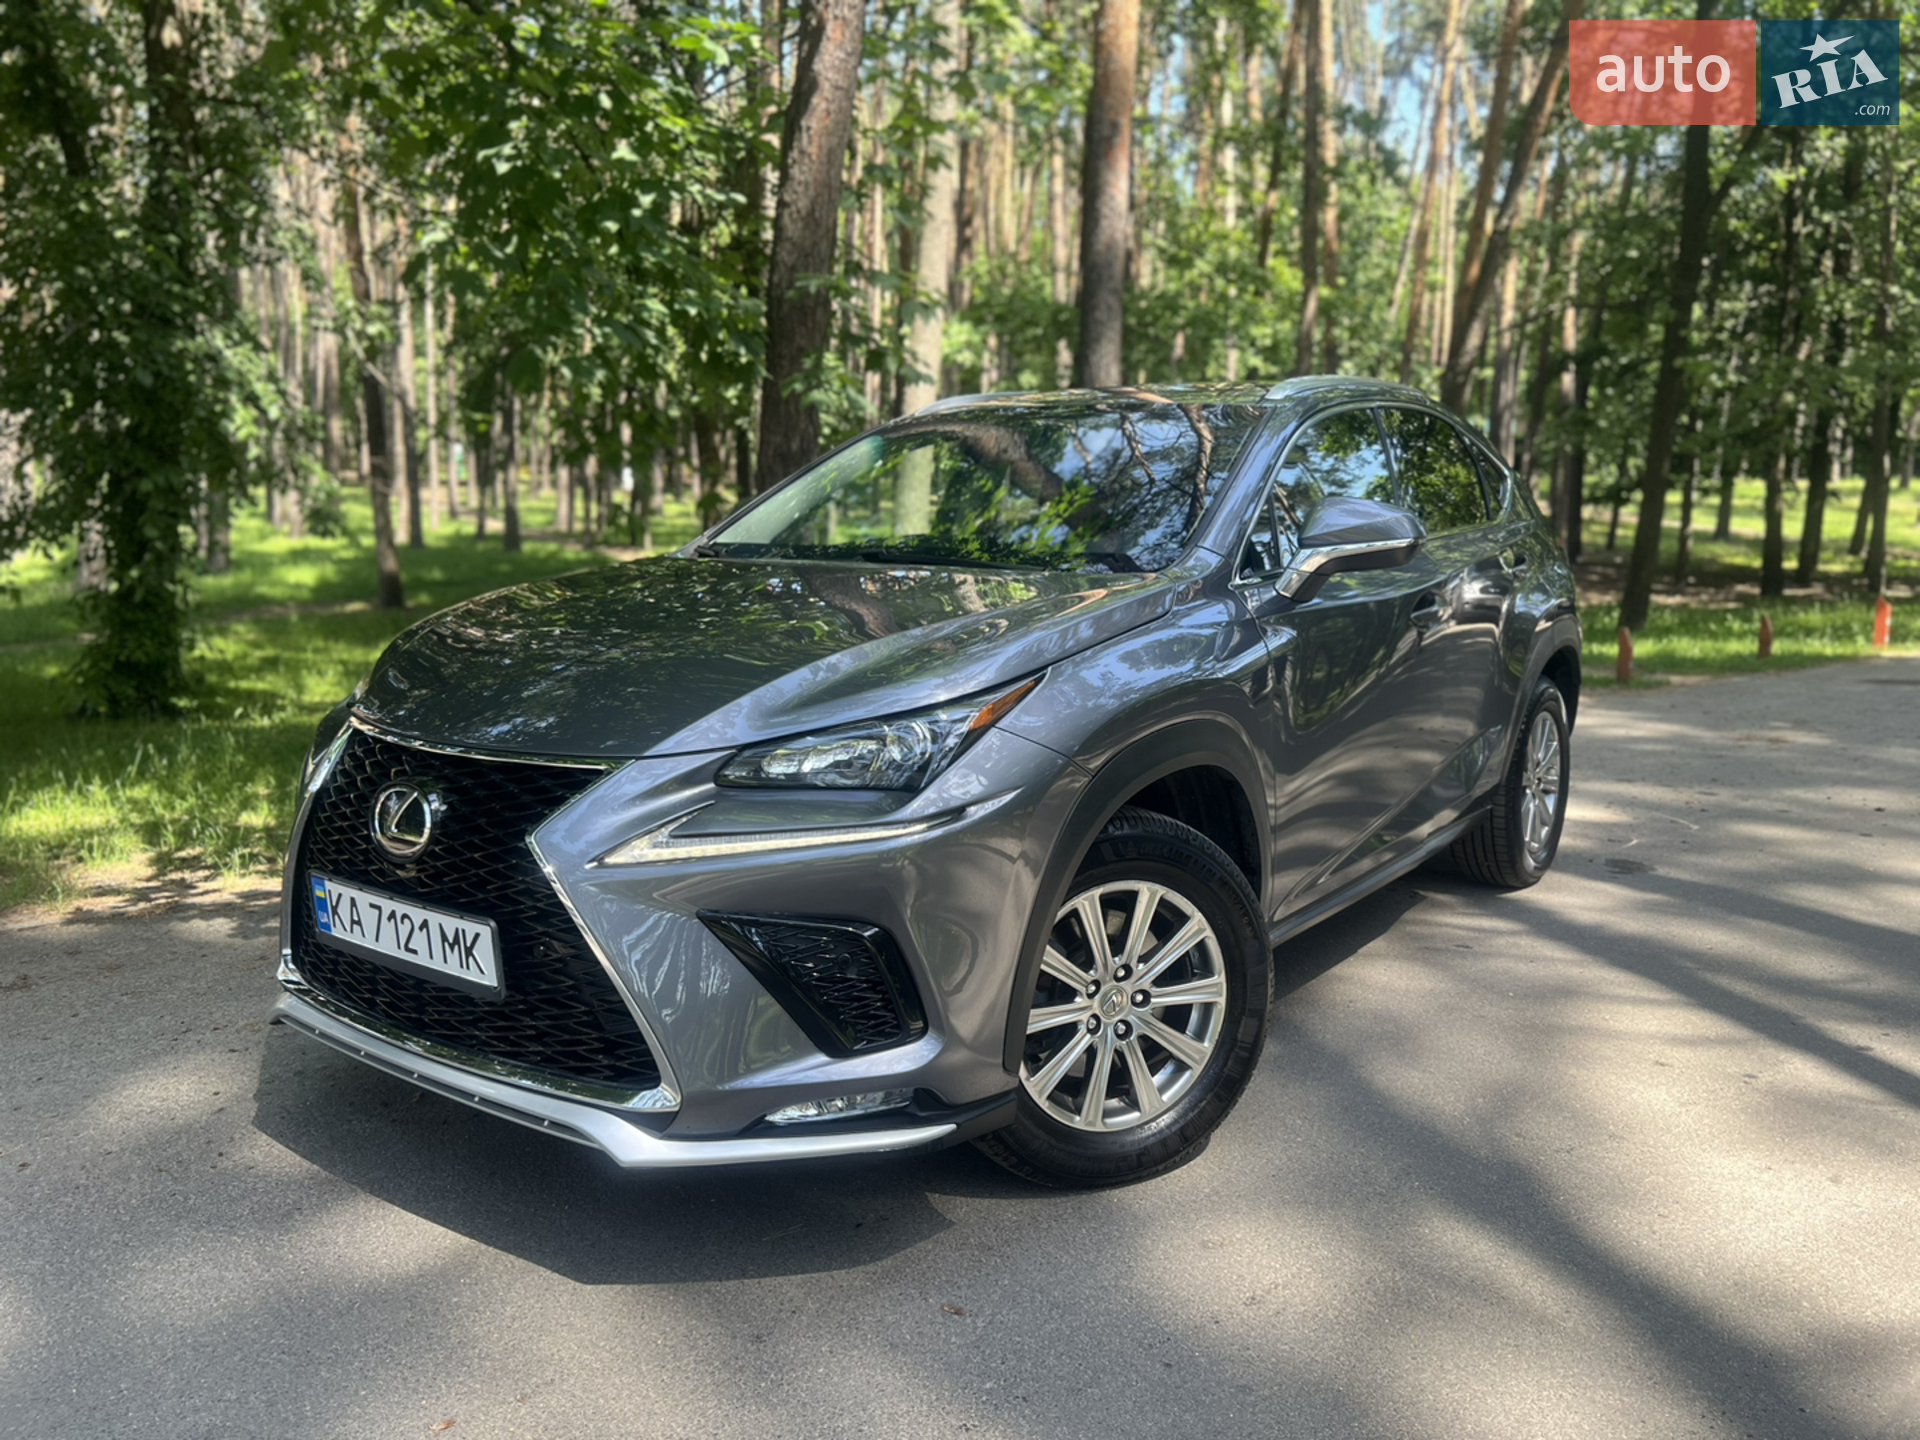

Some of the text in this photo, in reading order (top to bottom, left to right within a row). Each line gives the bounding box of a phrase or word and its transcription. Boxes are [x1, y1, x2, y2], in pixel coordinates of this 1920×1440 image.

[319, 912, 329, 925] UA
[328, 889, 486, 975] KA 7121 MK
